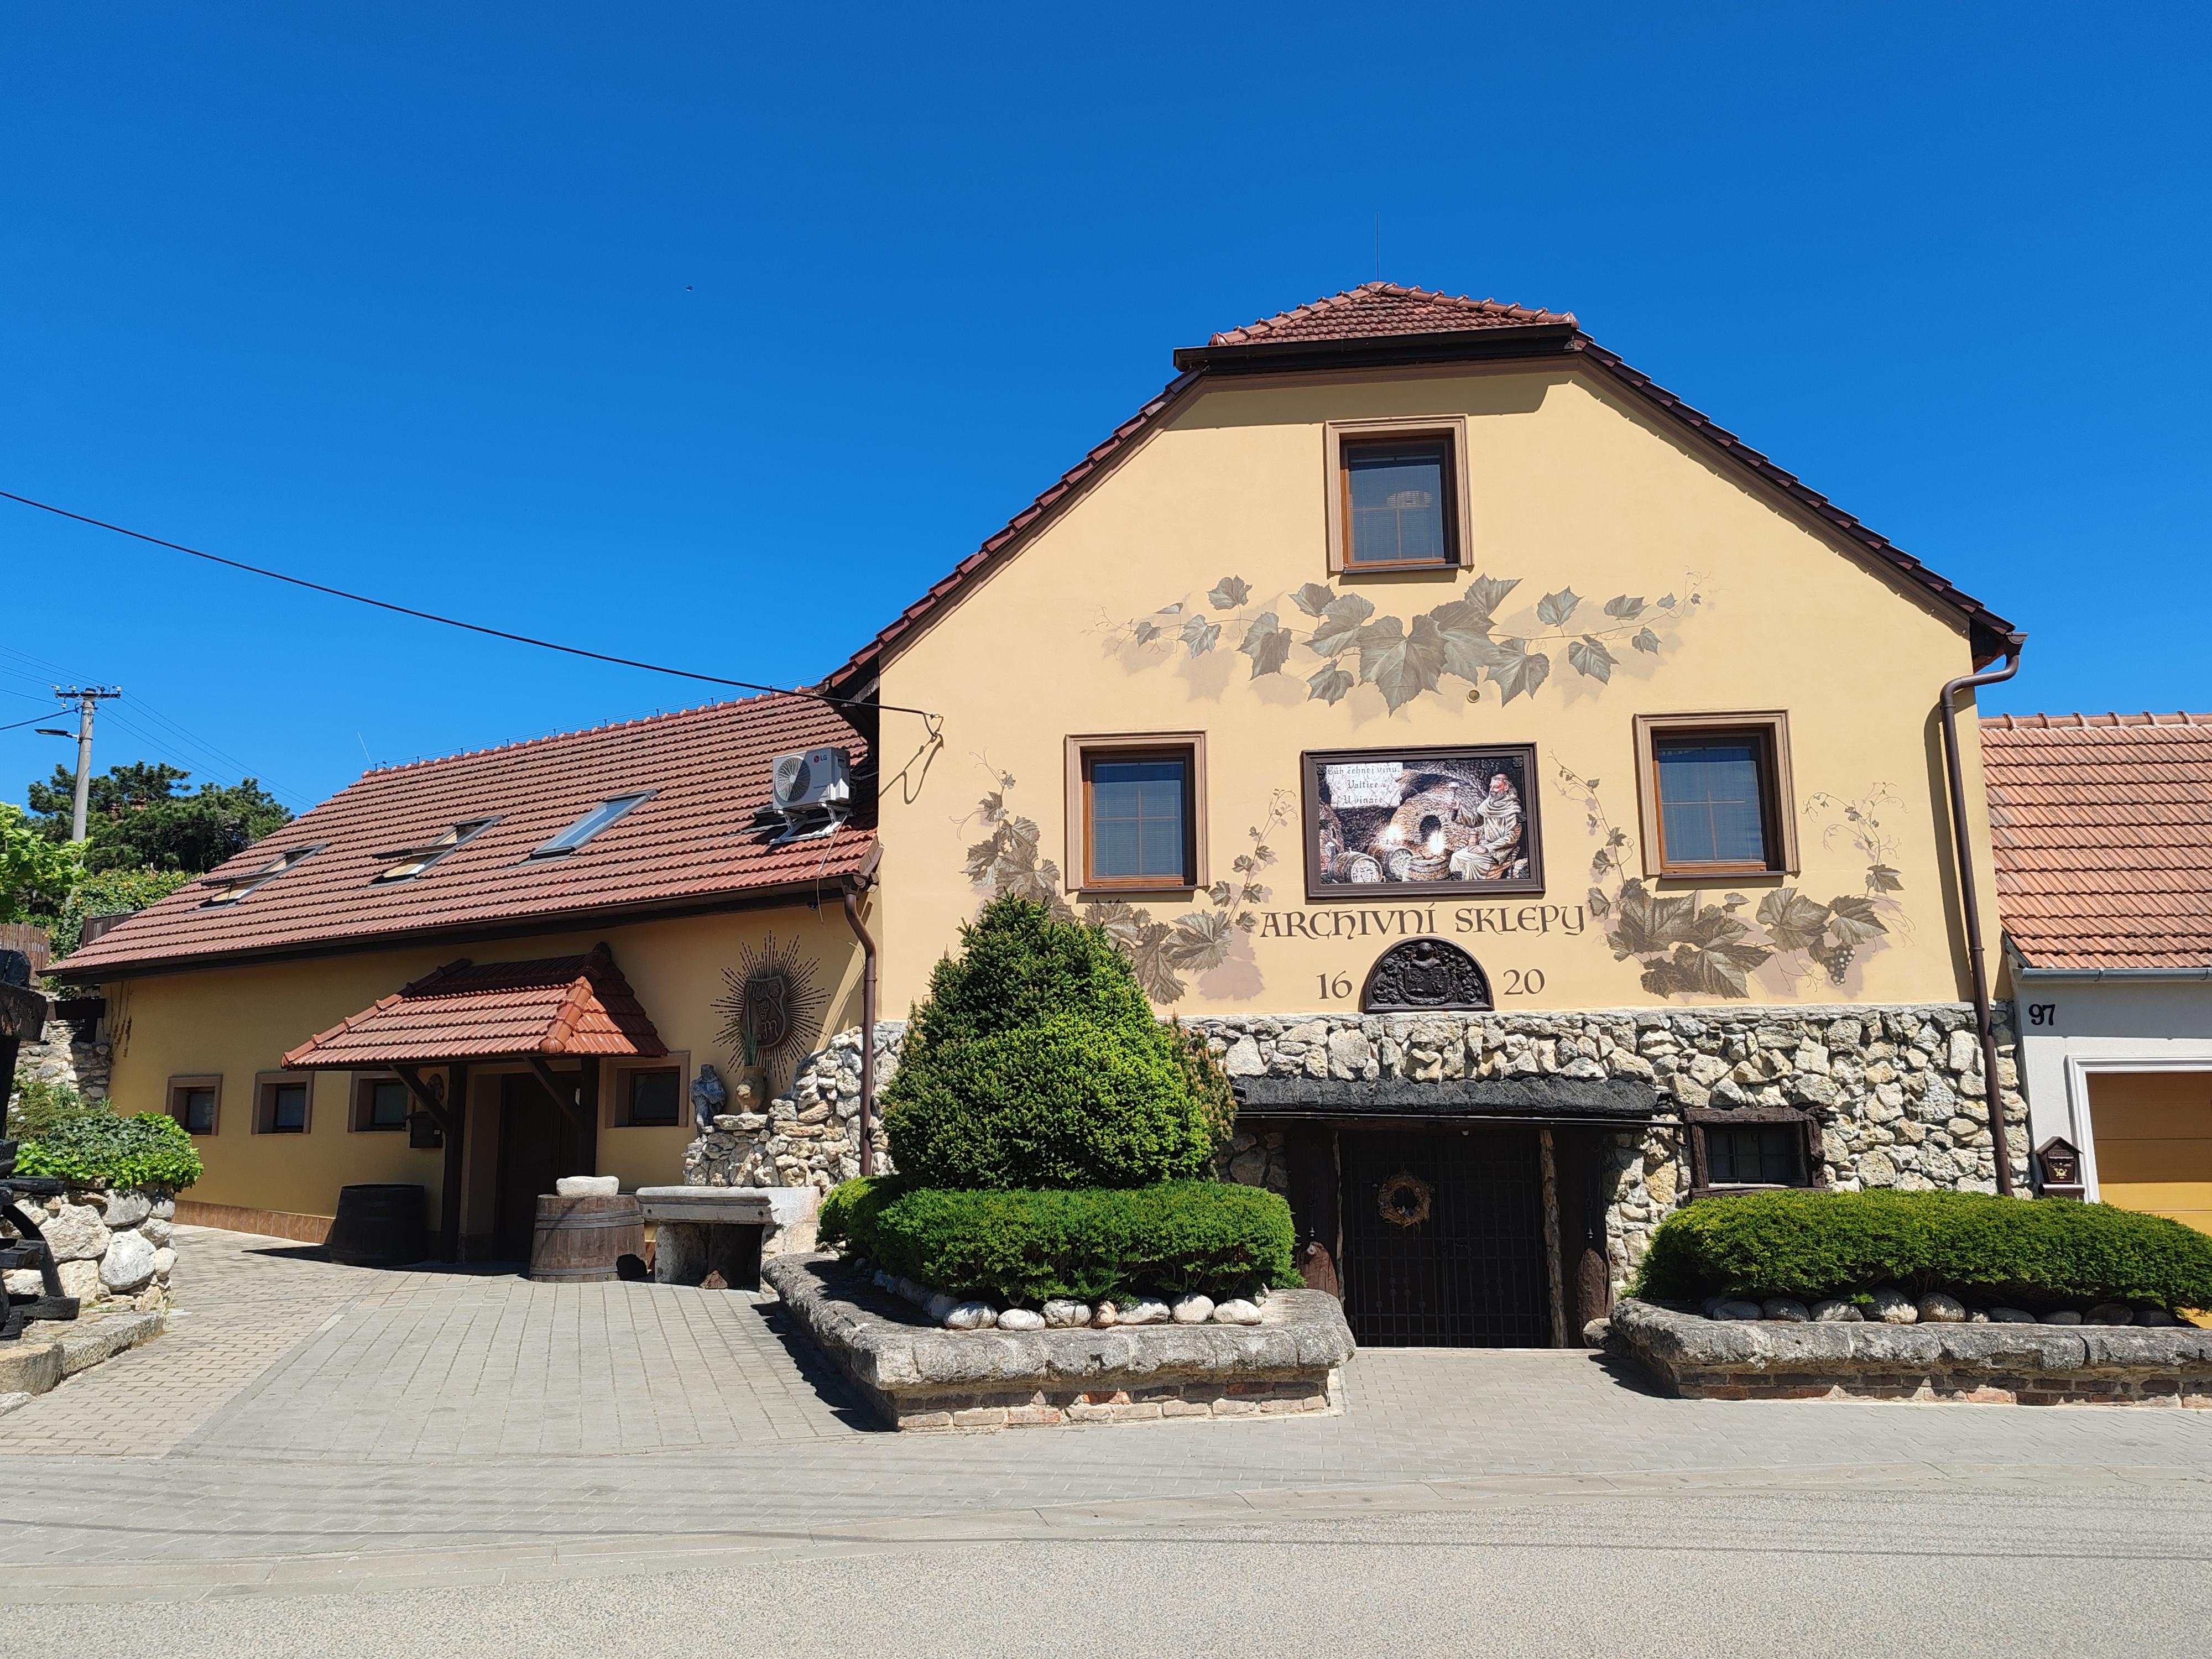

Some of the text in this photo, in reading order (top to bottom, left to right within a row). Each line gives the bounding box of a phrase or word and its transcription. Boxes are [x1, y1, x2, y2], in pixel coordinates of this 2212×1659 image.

[1347, 765, 1374, 776] žehnej
[1347, 780, 1379, 789] Valtice
[1260, 902, 1584, 940] ARCHIVNÍ SKLEPY
[1316, 968, 1546, 999] 16 20
[2028, 1003, 2056, 1026] 97
